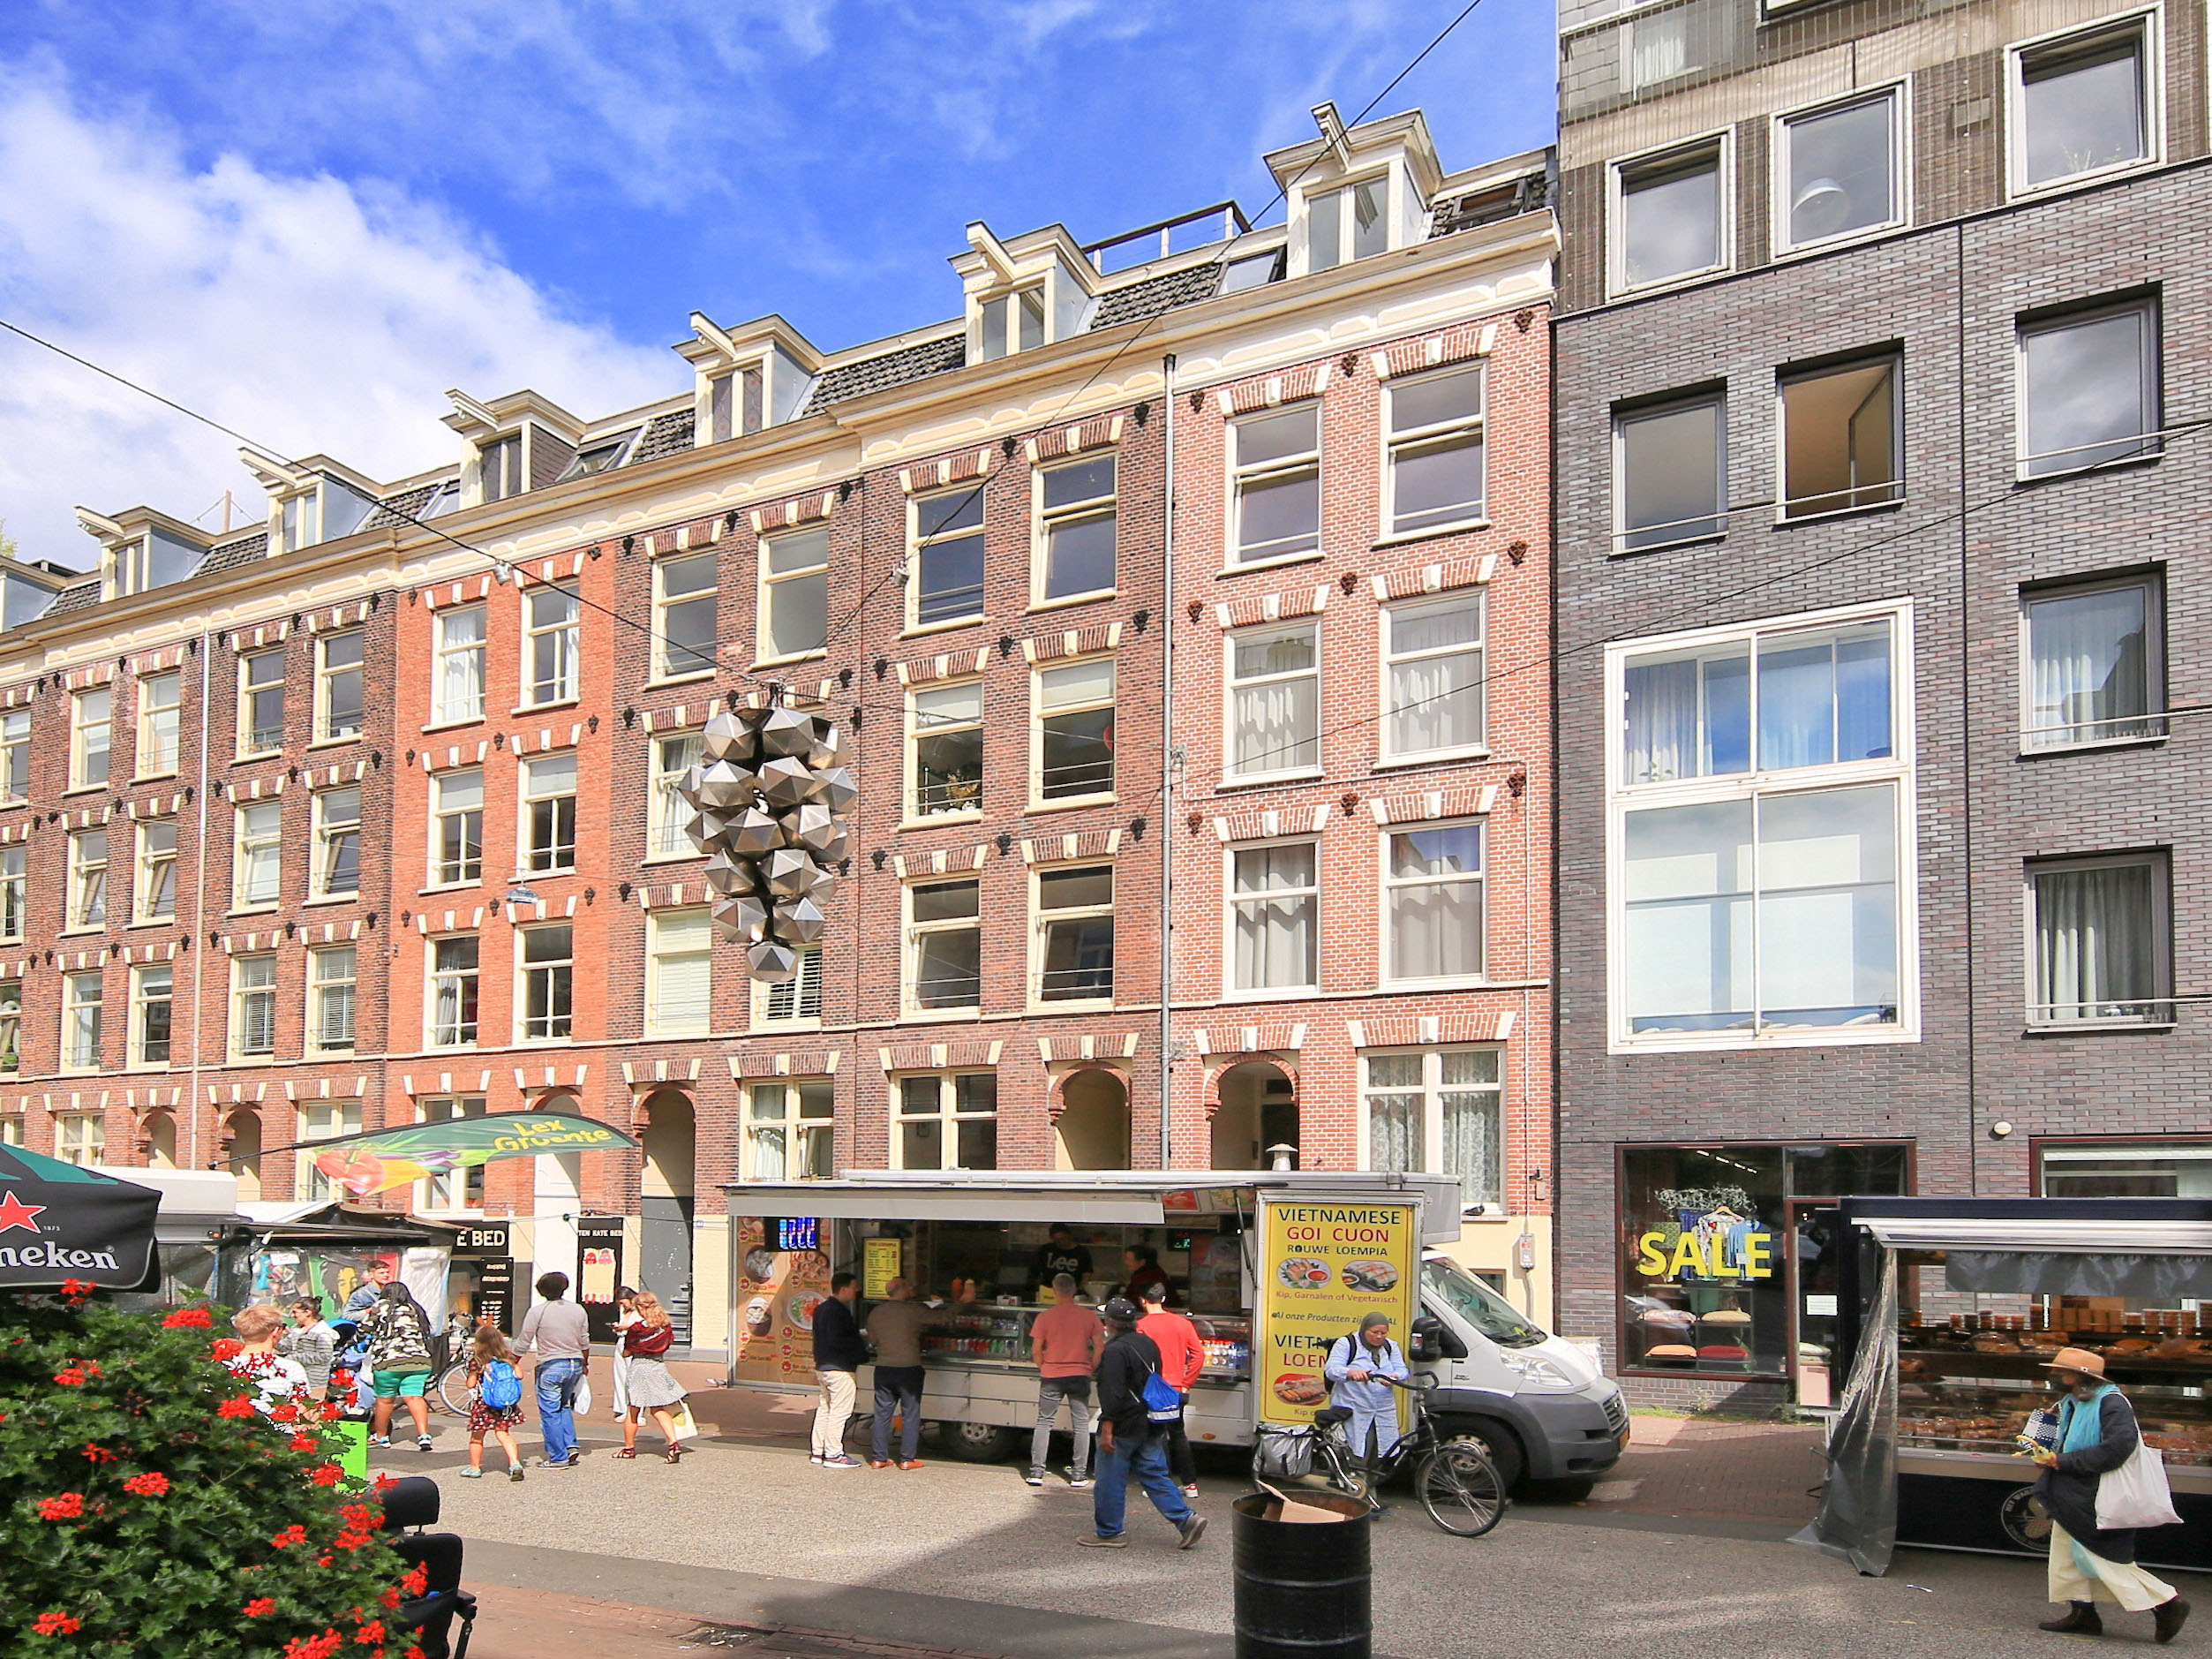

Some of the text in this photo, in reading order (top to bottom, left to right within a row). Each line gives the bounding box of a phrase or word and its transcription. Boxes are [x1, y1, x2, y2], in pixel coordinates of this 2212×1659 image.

[513, 1120, 566, 1136] Lex
[1278, 1209, 1401, 1225] VIETNAMESE
[471, 1230, 506, 1247] BED
[1287, 1226, 1389, 1243] GOI CUON
[0, 1241, 120, 1270] neken
[1287, 1244, 1388, 1256] ROUWE LOEMPIA
[1638, 1231, 1772, 1278] SALE
[1046, 1252, 1079, 1271] Lee
[1294, 1292, 1334, 1301] Garnalen
[1347, 1293, 1398, 1304] Vegetarisch
[1307, 1314, 1351, 1323] Producten
[1294, 1408, 1308, 1417] Kip
